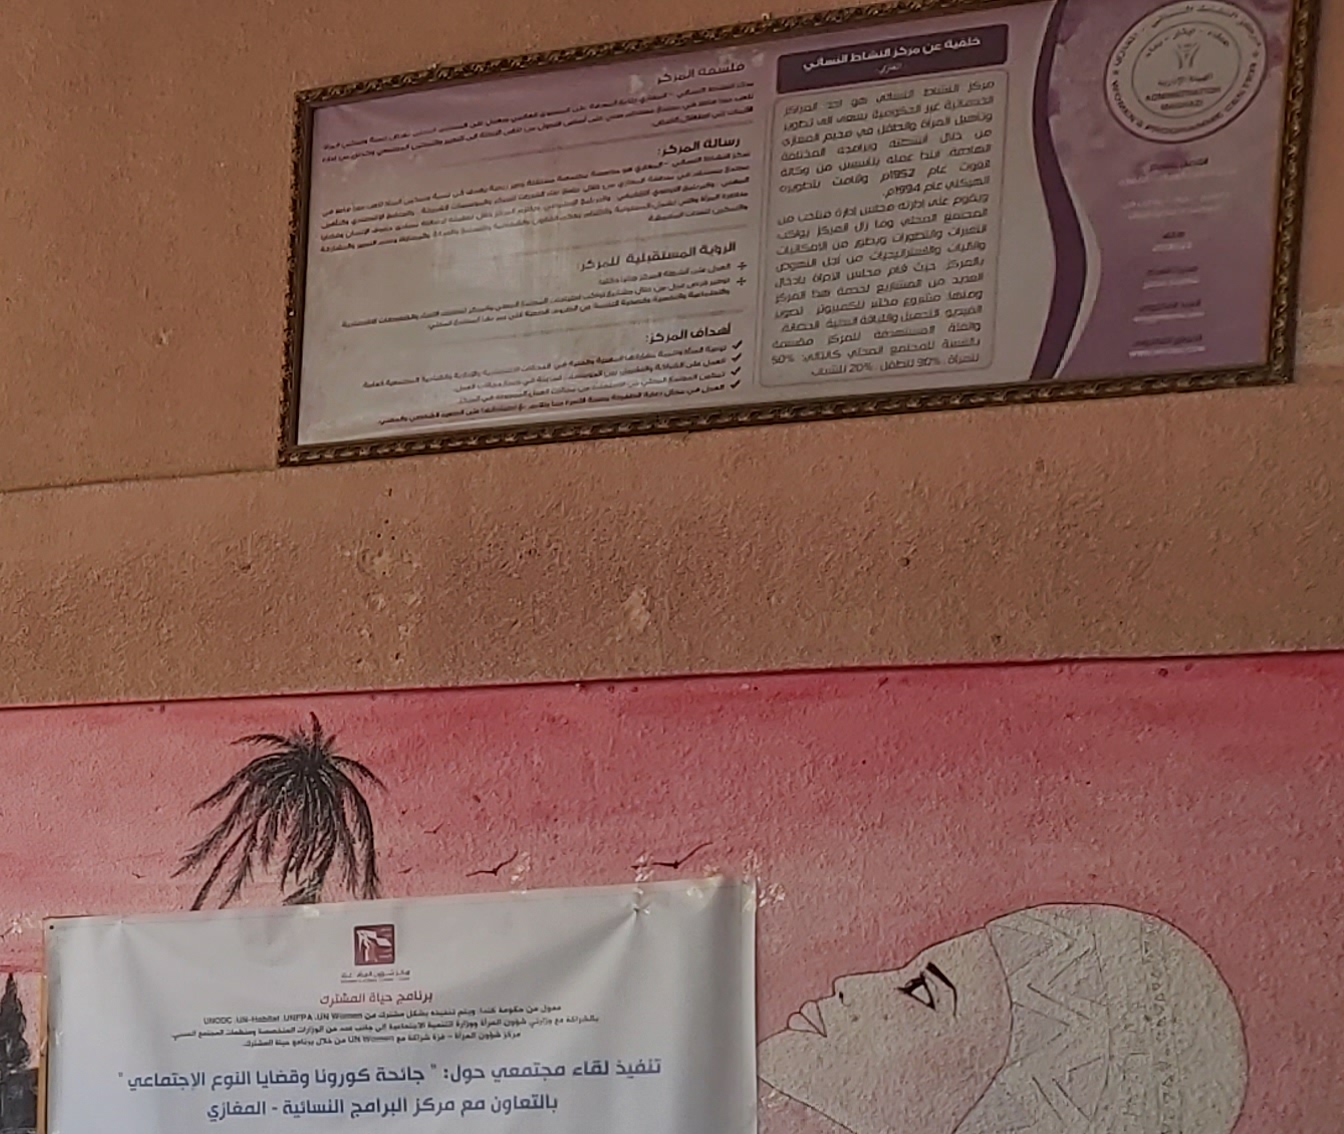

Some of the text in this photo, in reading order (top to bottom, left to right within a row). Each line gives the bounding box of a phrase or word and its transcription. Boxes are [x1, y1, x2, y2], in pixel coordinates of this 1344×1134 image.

[803, 36, 981, 71] خلفية عن مركز النشاط النسائي
[319, 990, 434, 1008] برنامج حياة المشترك
[365, 1013, 377, 1021] من
[498, 1006, 524, 1015] حكومة
[526, 1006, 539, 1015] من
[376, 1065, 425, 1085] جائحة
[443, 1064, 486, 1084] حول:
[491, 1062, 565, 1083] مجتمعي
[572, 1057, 609, 1076] لقاء
[615, 1058, 662, 1079] تنفيذ
[211, 1071, 251, 1091] النوع
[256, 1069, 310, 1089] وقضايا
[314, 1067, 371, 1087] كورونا
[206, 1093, 558, 1121] بالتعاون مع مركز البرامج النسائية المغازي
